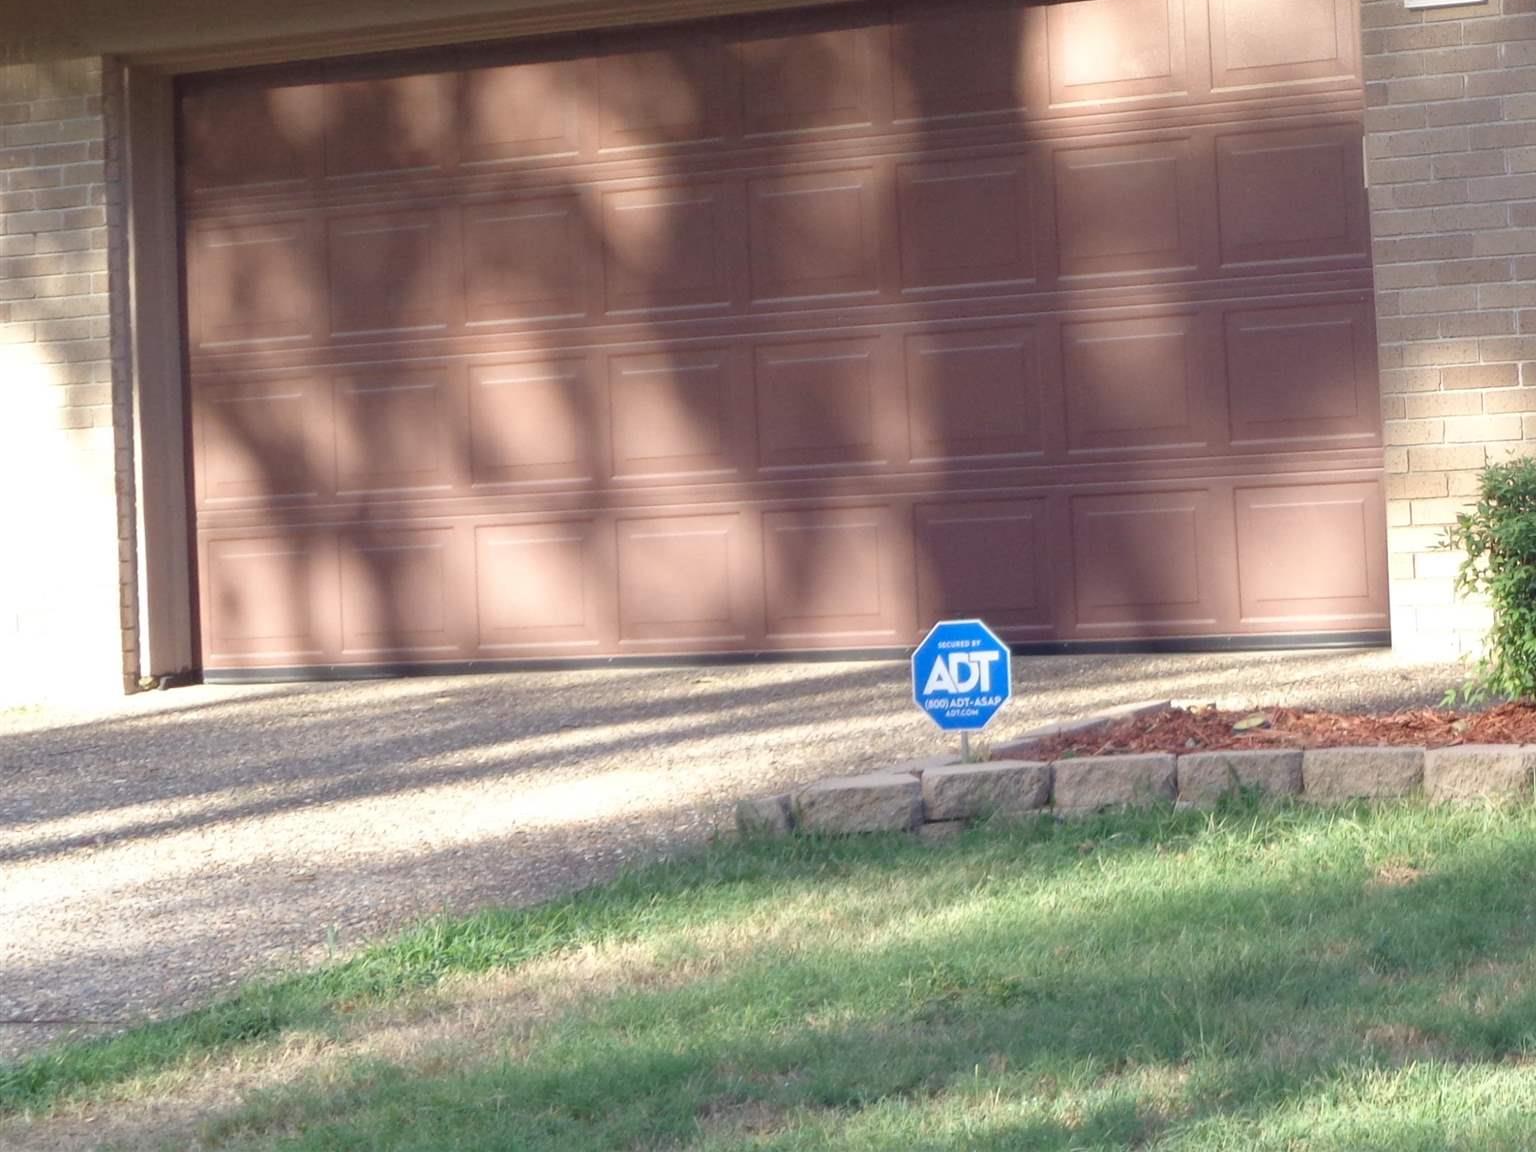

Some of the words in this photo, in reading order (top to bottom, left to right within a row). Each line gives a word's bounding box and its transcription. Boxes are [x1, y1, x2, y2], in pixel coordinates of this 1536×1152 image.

[938, 641, 970, 649] SECURED
[923, 650, 999, 695] ADT
[946, 709, 979, 717] ADT.COM
